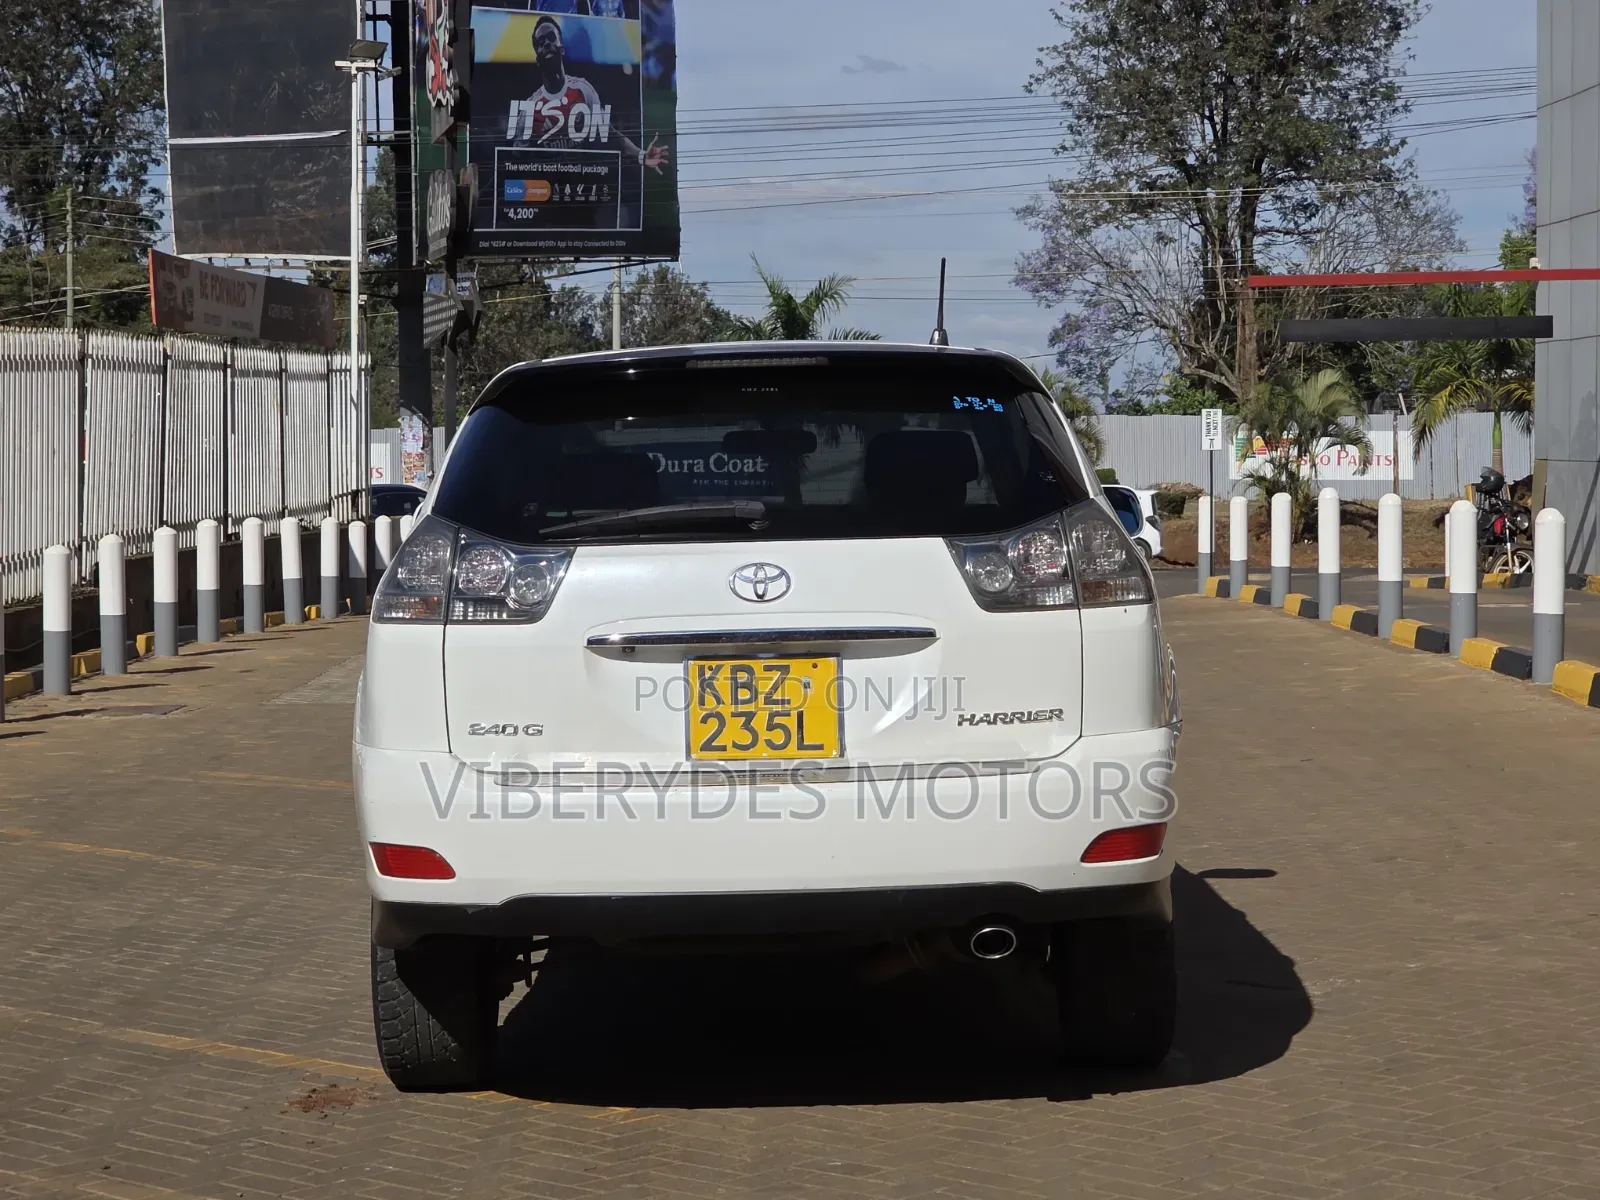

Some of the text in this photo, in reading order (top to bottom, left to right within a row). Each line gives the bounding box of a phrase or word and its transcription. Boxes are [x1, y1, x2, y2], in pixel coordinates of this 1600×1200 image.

[506, 99, 611, 144] IT'S ON
[505, 162, 608, 176] The world's best football package
[507, 207, 535, 220] 4,200
[479, 240, 490, 248] Dial
[513, 240, 538, 248] Download
[557, 240, 567, 249] App
[573, 240, 583, 249] stay
[211, 273, 247, 308] FORWARD
[697, 663, 792, 706] KBZ
[699, 709, 825, 752] 235L
[957, 708, 1065, 727] HARRIER
